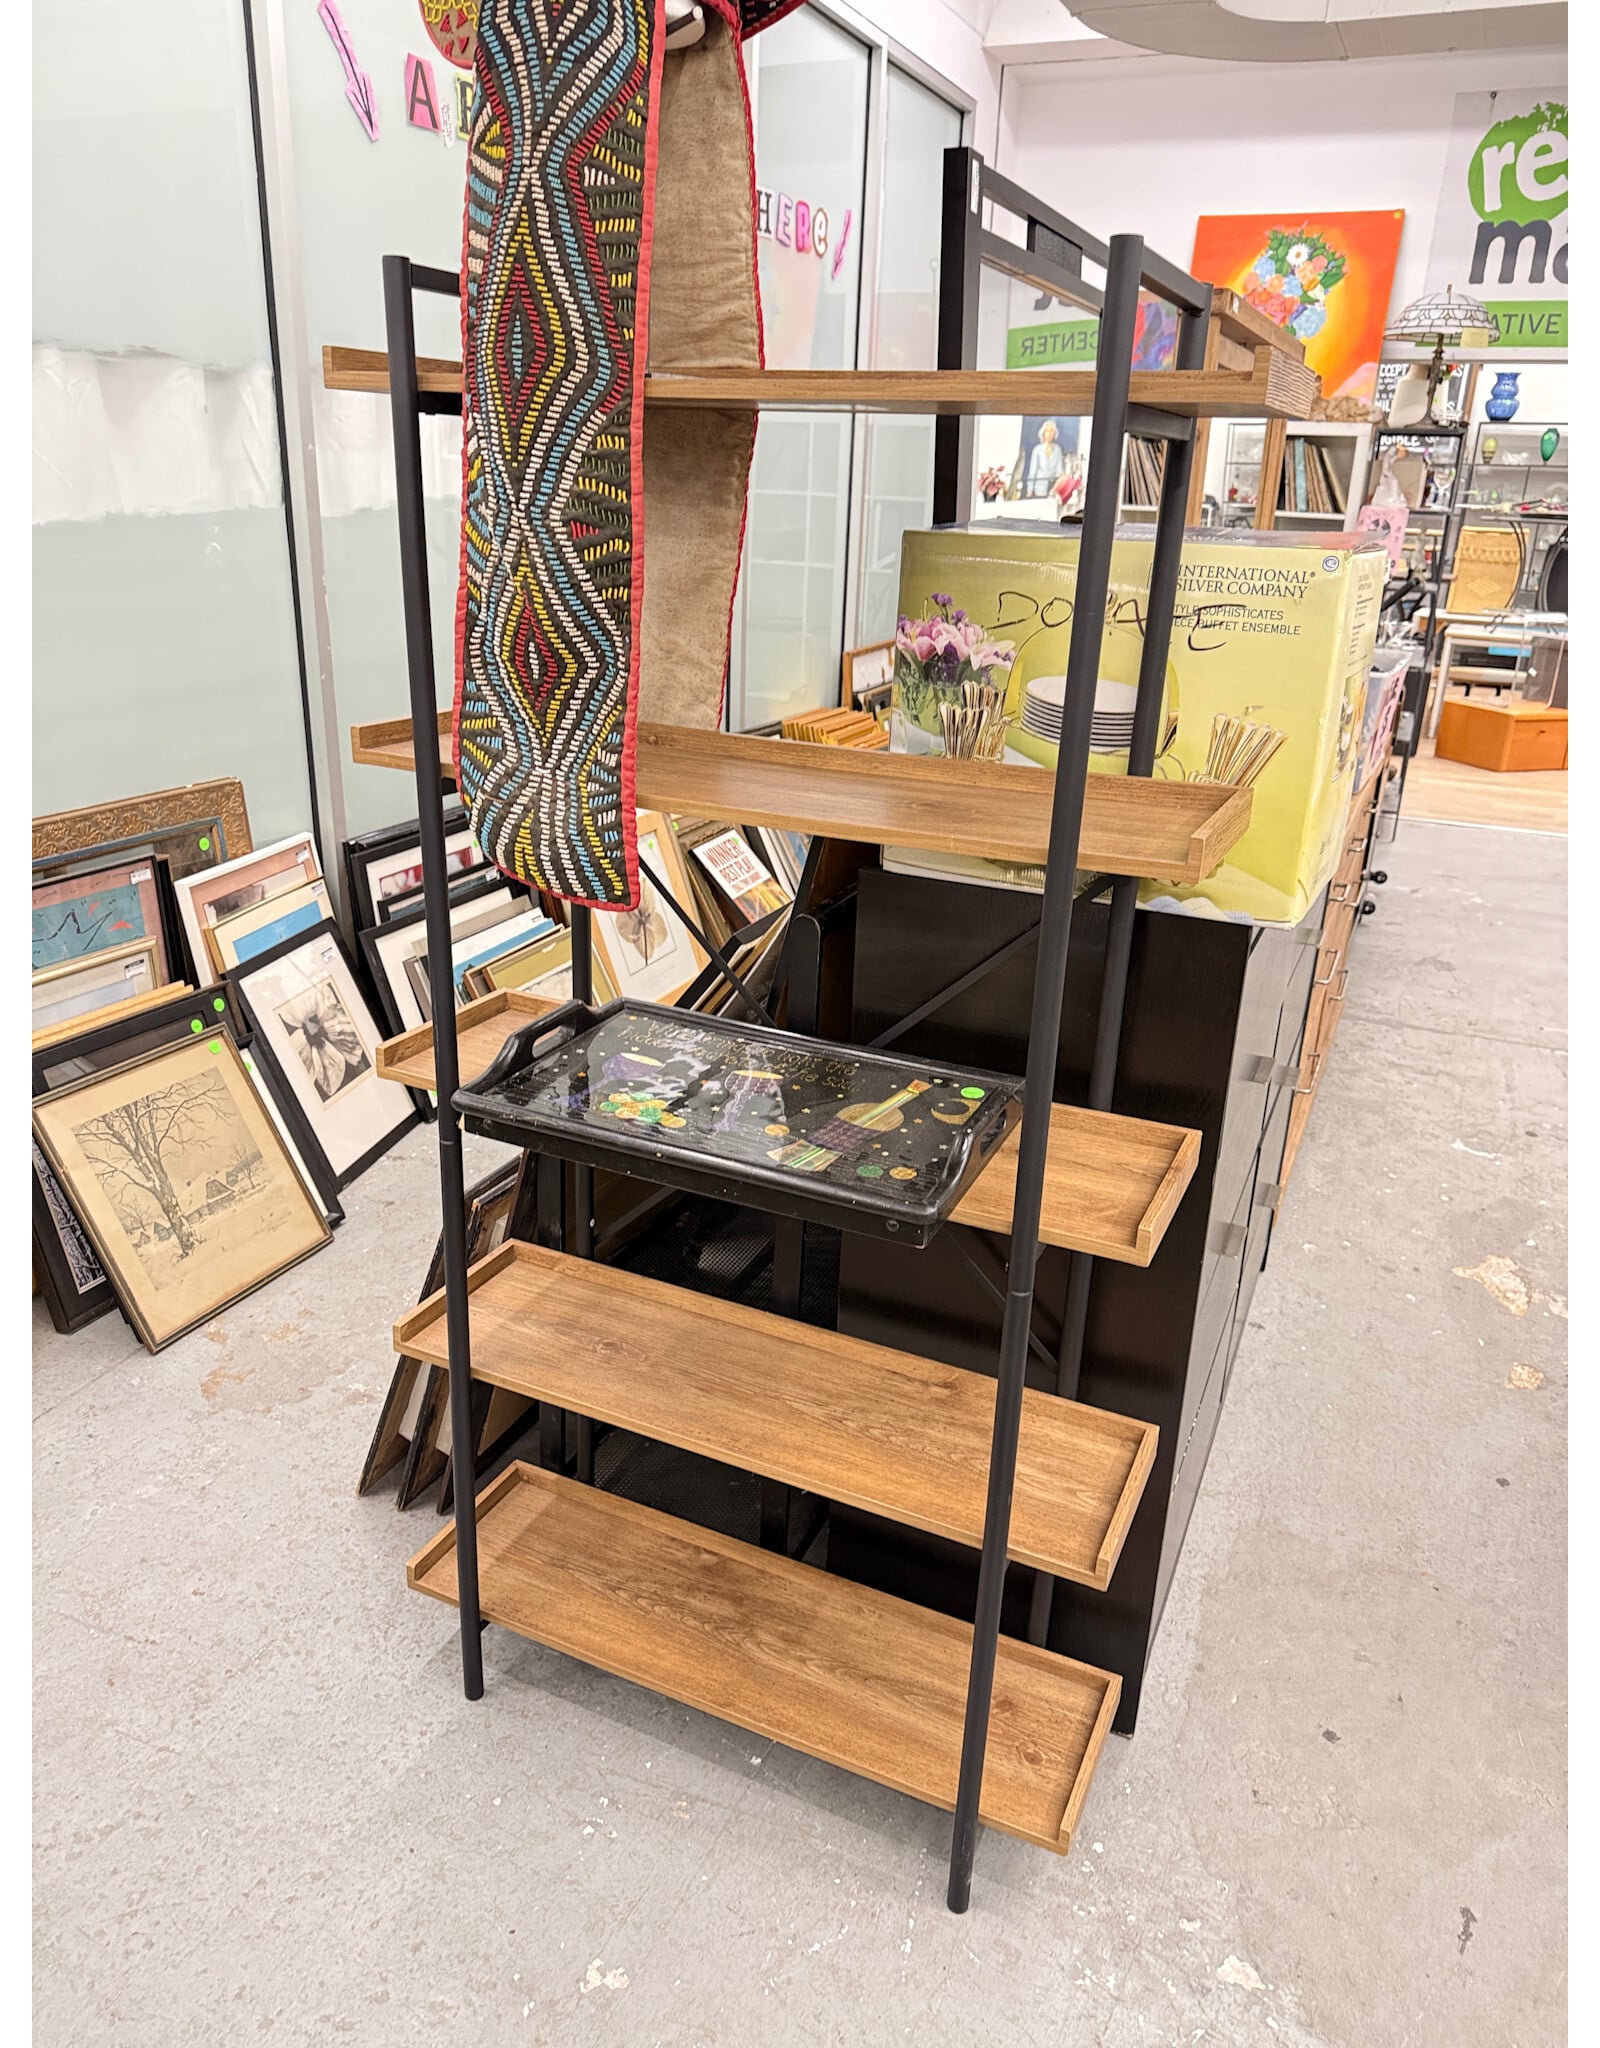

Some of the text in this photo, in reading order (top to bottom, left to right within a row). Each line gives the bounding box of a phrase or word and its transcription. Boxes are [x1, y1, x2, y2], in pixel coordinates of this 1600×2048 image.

[1489, 312, 1562, 335] ATIVE
[1175, 578, 1308, 599] SILVER COMPANY
[1174, 603, 1285, 621] TYLE SOPHISTICATES
[1173, 617, 1302, 636] ECE BUFFET ENSEMBLE
